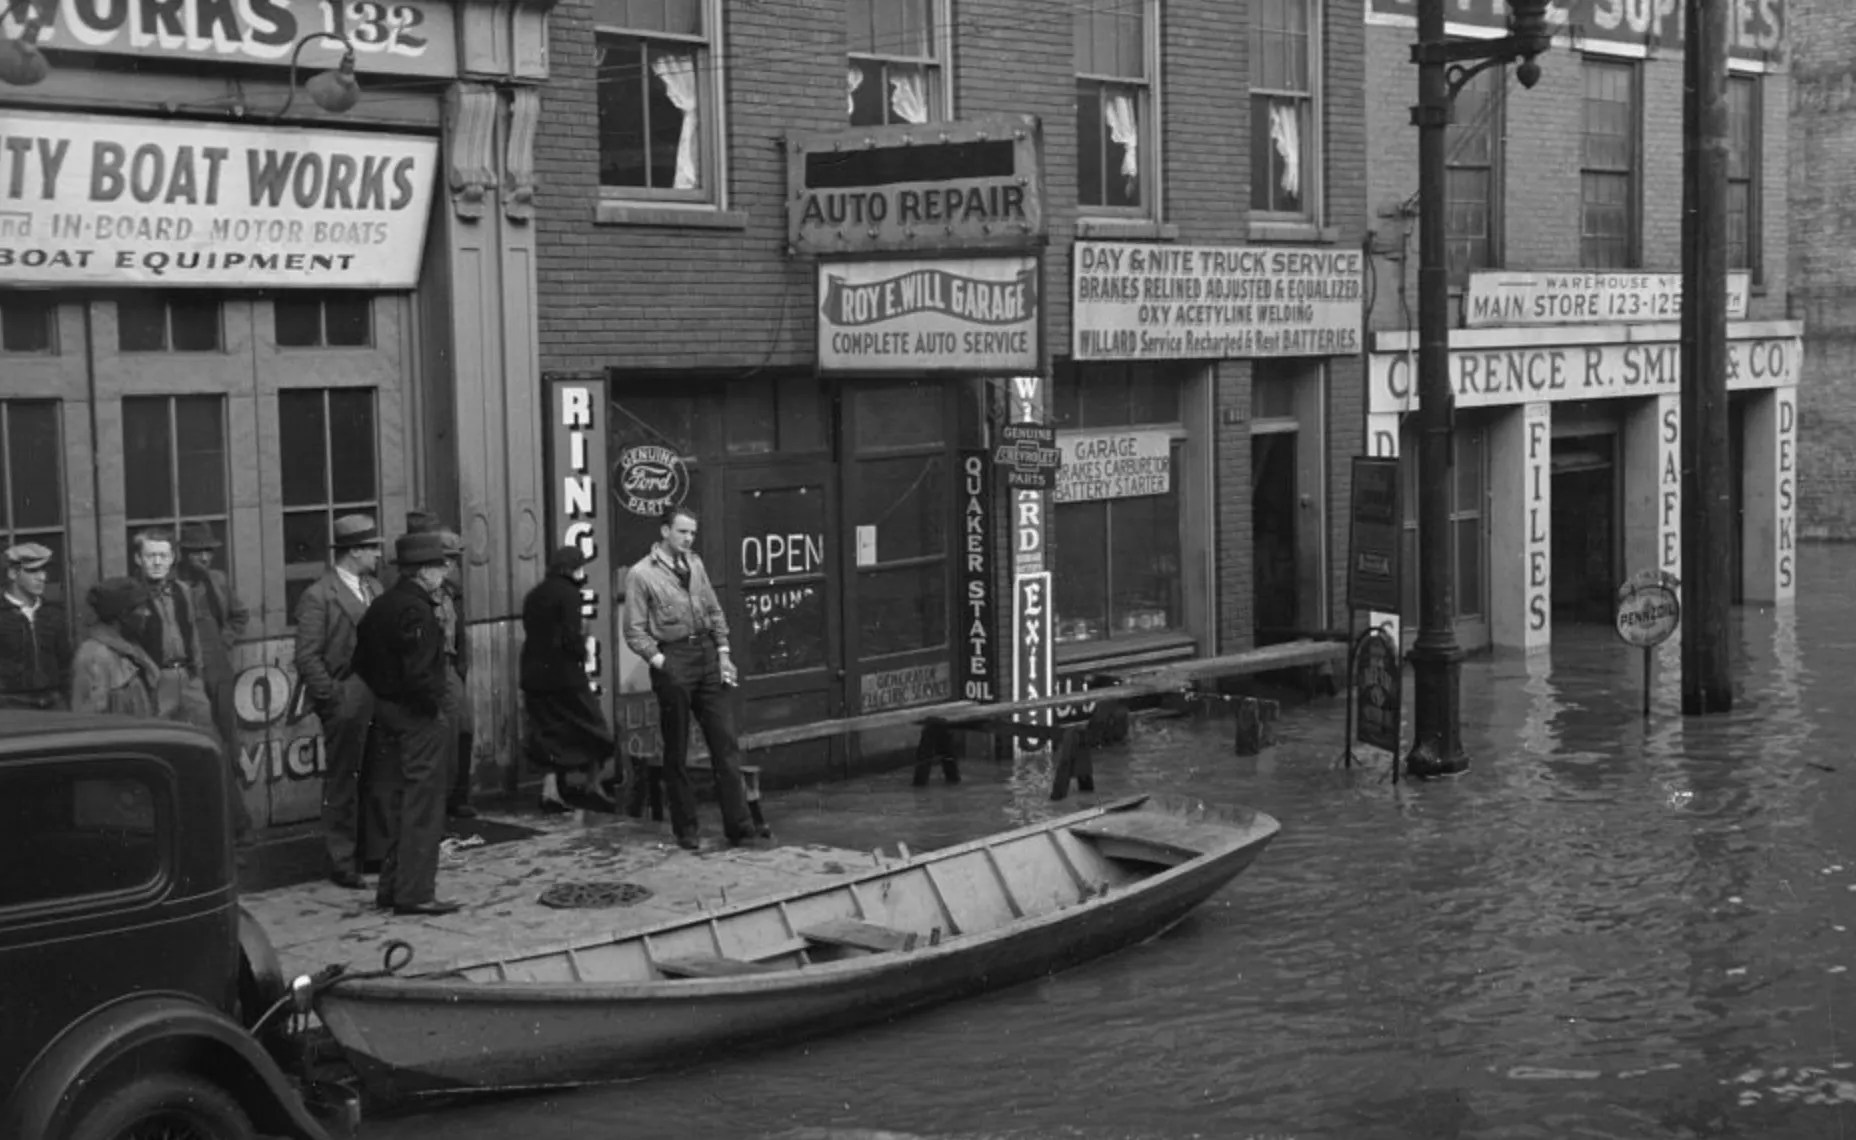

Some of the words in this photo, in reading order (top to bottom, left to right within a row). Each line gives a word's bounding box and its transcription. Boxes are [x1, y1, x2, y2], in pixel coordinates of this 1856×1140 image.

[318, 0, 427, 56] 132
[0, 136, 70, 200] TY
[88, 140, 229, 206] BOAT
[246, 149, 416, 211] WORKS
[802, 192, 888, 224] AUTO
[899, 186, 1026, 221] REPAIR
[210, 217, 303, 243] MOTOR
[313, 220, 389, 246] BOATS
[0, 248, 95, 269] BOAT
[114, 250, 357, 275] EQUIPMENT
[1081, 248, 1124, 271] DAY
[1129, 249, 1146, 271] &
[1148, 249, 1194, 272] NITE
[1200, 250, 1266, 273] TRUCK
[1271, 251, 1360, 274] SERVICE
[1079, 276, 1140, 300] BRAKES
[1143, 277, 1201, 300] RELINED
[1205, 278, 1272, 300] ADJUSTED
[1546, 276, 1649, 290] WAREHOUSE
[841, 285, 881, 324] ROY
[901, 272, 946, 311] WILL
[951, 280, 1026, 321] GARAGE
[1474, 294, 1526, 318] MAIN
[1533, 293, 1600, 317] STORE
[1138, 304, 1172, 324] OXY
[1175, 304, 1253, 324] ACETYLINE
[1257, 303, 1314, 324] WELDING
[832, 332, 910, 355] COMPLETE
[915, 331, 957, 354] AUTO
[963, 331, 1029, 354] SERVICE
[1079, 330, 1138, 354] WILLARD
[1140, 329, 1182, 352] Service
[1387, 350, 1567, 398] CRENCE
[1623, 343, 1680, 386] SMI
[1726, 345, 1741, 380] &
[1002, 426, 1053, 441] GENUINE
[621, 446, 680, 470] GENUINE
[1074, 437, 1137, 461] GARAGE
[1013, 376, 1041, 552] WIRD
[623, 465, 673, 491] Ford
[1009, 472, 1047, 487] PARTS
[1054, 479, 1112, 502] BATTERY
[1115, 474, 1166, 497] STARTER
[1778, 400, 1794, 588] DESKS
[965, 456, 984, 573] QUAKER
[1528, 421, 1547, 632] FILES
[741, 533, 824, 577] OPEN
[967, 580, 988, 676] STATE
[965, 680, 993, 701] OIL
